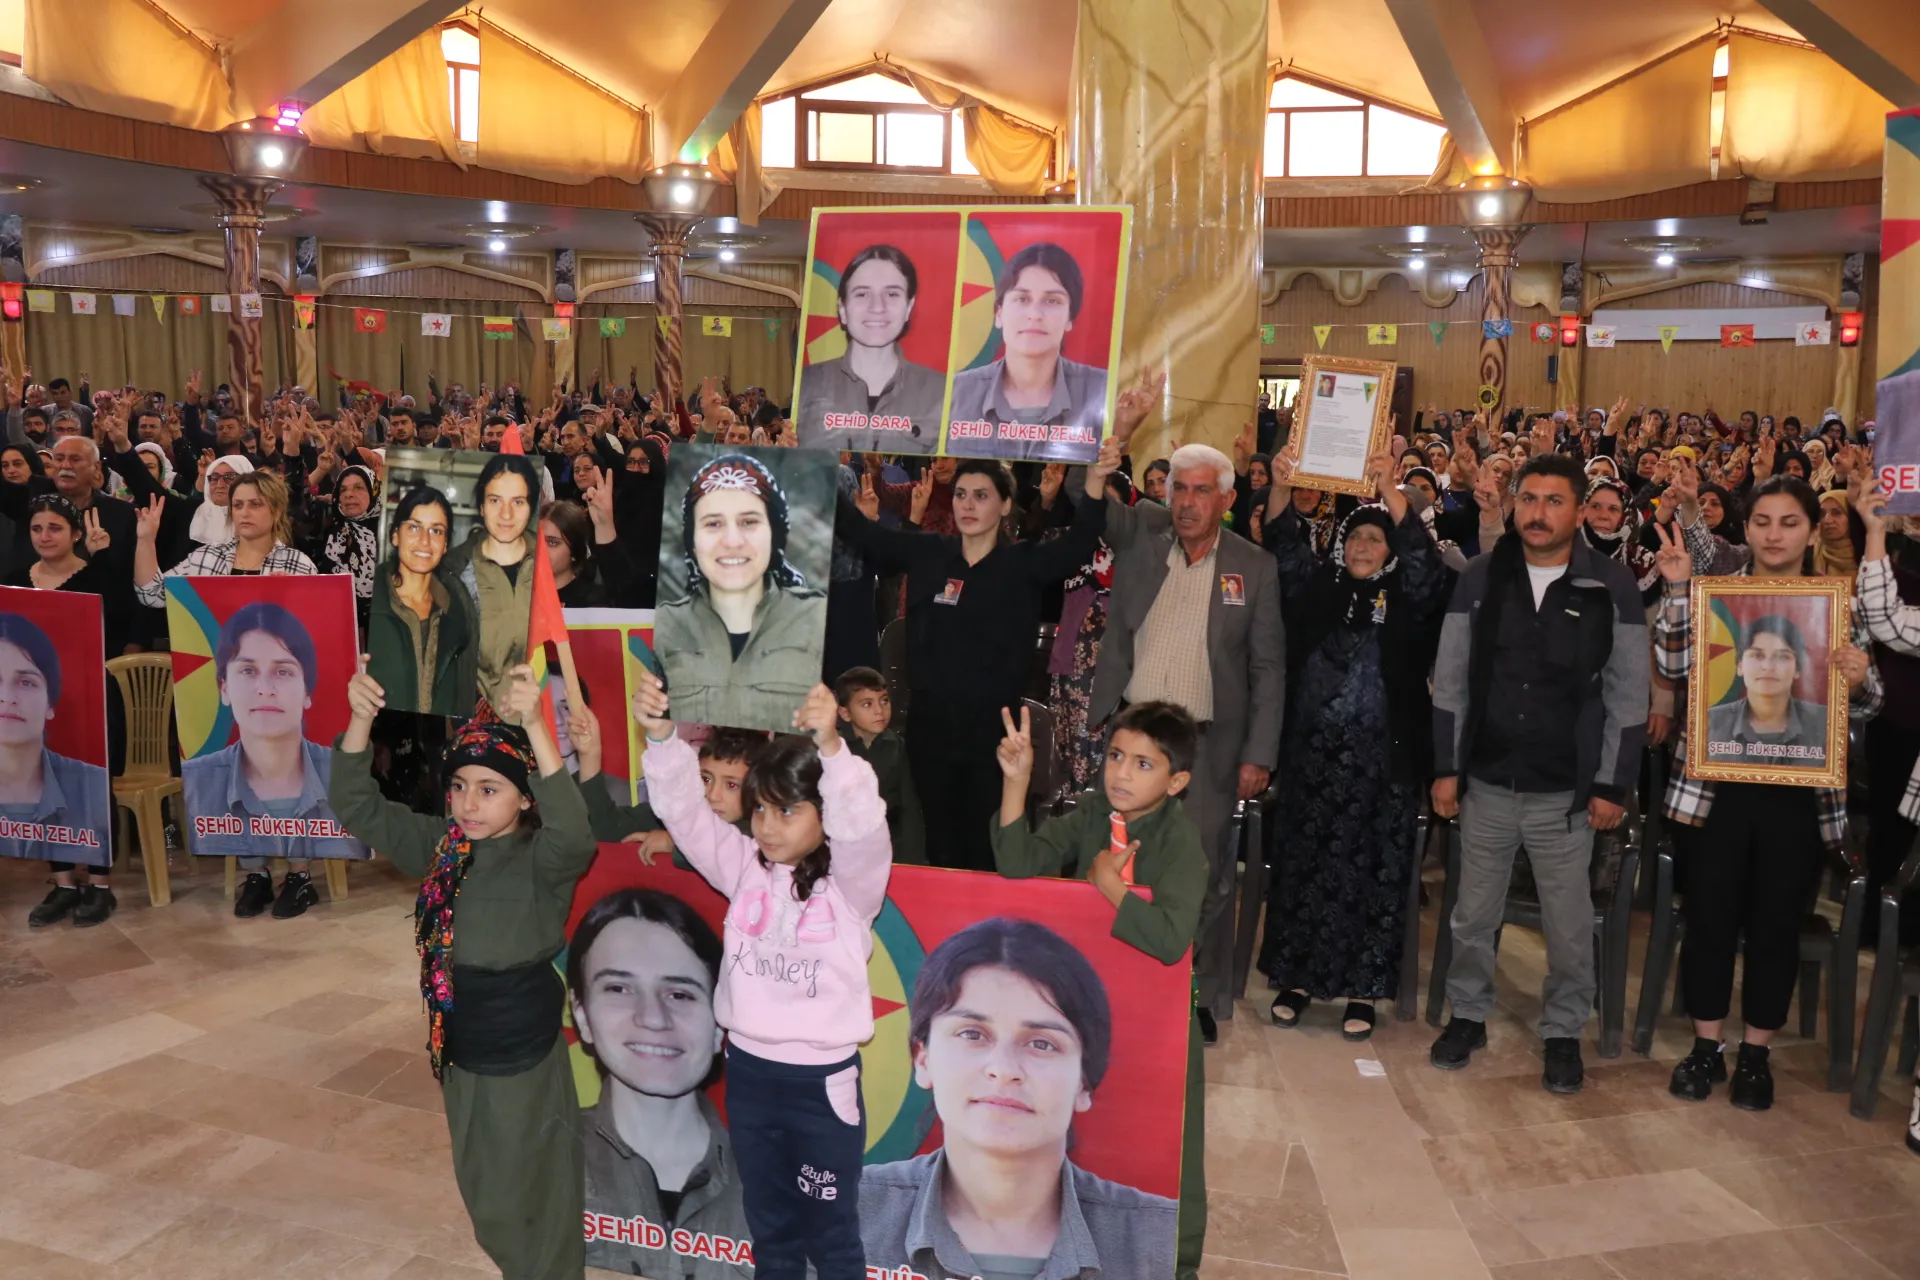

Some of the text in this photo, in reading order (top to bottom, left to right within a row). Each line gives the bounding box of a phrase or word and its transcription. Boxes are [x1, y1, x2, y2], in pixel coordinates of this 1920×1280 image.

[824, 411, 911, 430] ŞEHÎD SARA
[951, 418, 1096, 443] ŞEHÎD RÛKEN ZELAL
[1880, 466, 1920, 497] ŞE
[1708, 741, 1825, 759] ŞEHÎD RÛKEN ZELAL
[0, 816, 99, 847] ÛKEN ZELAL
[195, 813, 354, 838] ŞEHÎD RÛKEN ZELA
[729, 941, 820, 998] Kinley
[582, 1211, 756, 1268] ŞEHÎD SARA
